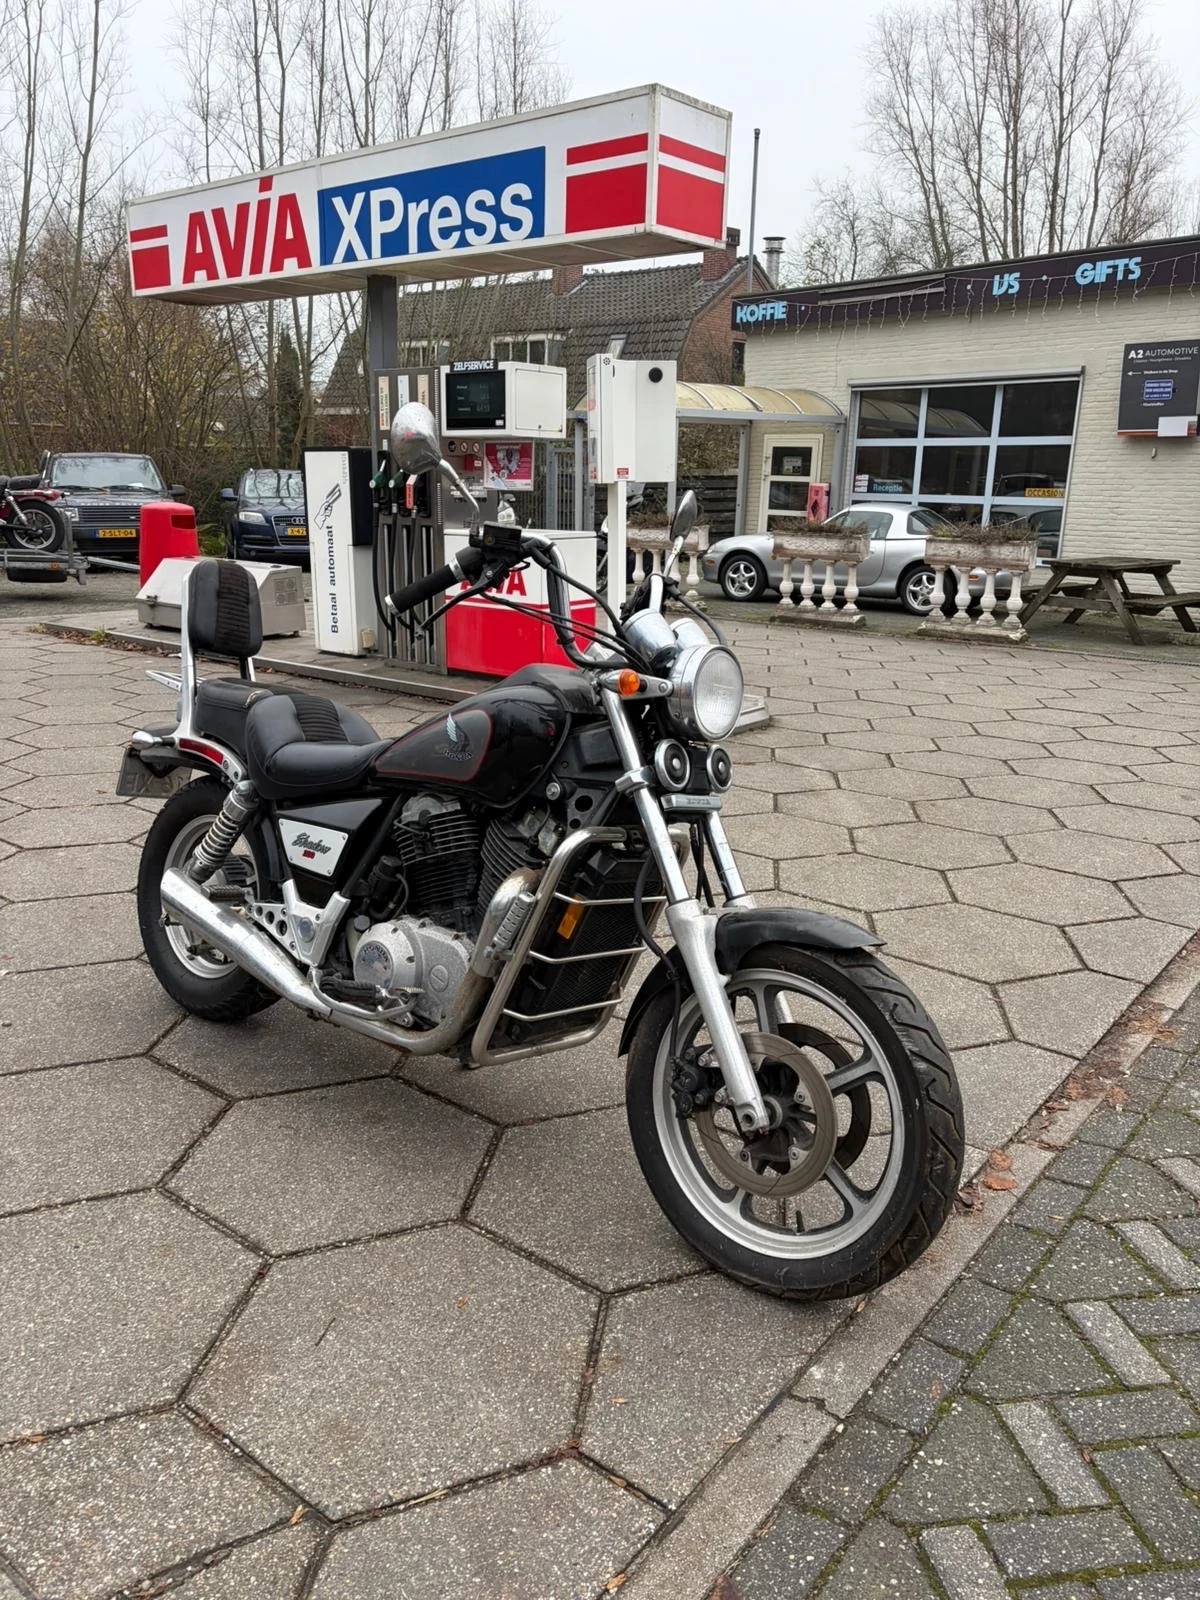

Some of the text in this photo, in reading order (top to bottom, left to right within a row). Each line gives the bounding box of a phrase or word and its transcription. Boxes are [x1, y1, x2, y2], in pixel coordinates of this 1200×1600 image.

[331, 182, 535, 265] XPress
[735, 300, 788, 323] KOFFIE
[1074, 256, 1142, 286] GIFTS
[453, 360, 494, 371] ZELFSERVICE
[1128, 346, 1199, 359] A2 AUTOMOTIVE
[1027, 488, 1064, 497] OCCASION
[325, 525, 339, 634] Betaal automaat
